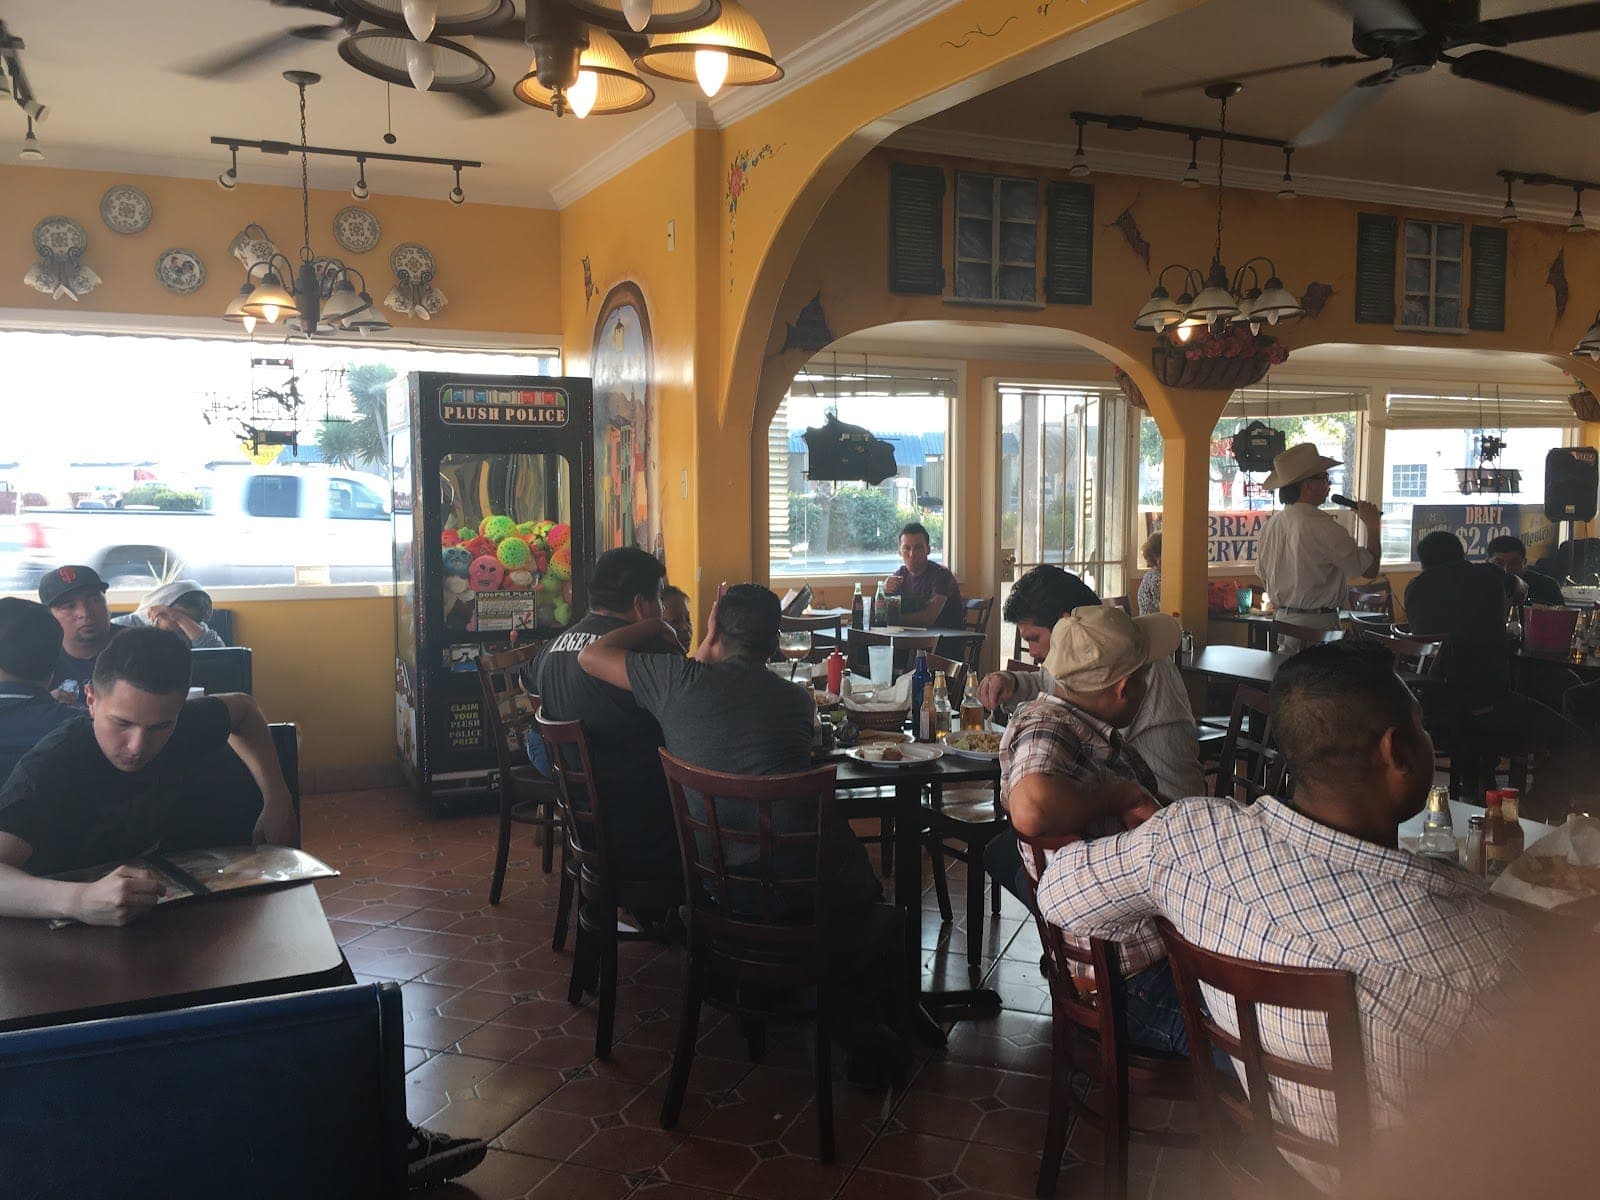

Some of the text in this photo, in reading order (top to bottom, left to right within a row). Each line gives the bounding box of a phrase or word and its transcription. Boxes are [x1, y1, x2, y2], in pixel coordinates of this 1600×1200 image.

[444, 406, 566, 422] PLUSH POLICE
[1465, 506, 1504, 525] DRAFT
[1208, 515, 1271, 537] BREA
[450, 703, 479, 711] CLAIM
[453, 712, 479, 720] YOUR
[450, 719, 480, 728] PLUSH
[449, 729, 482, 738] POLICE
[452, 738, 479, 746] PRIZE
